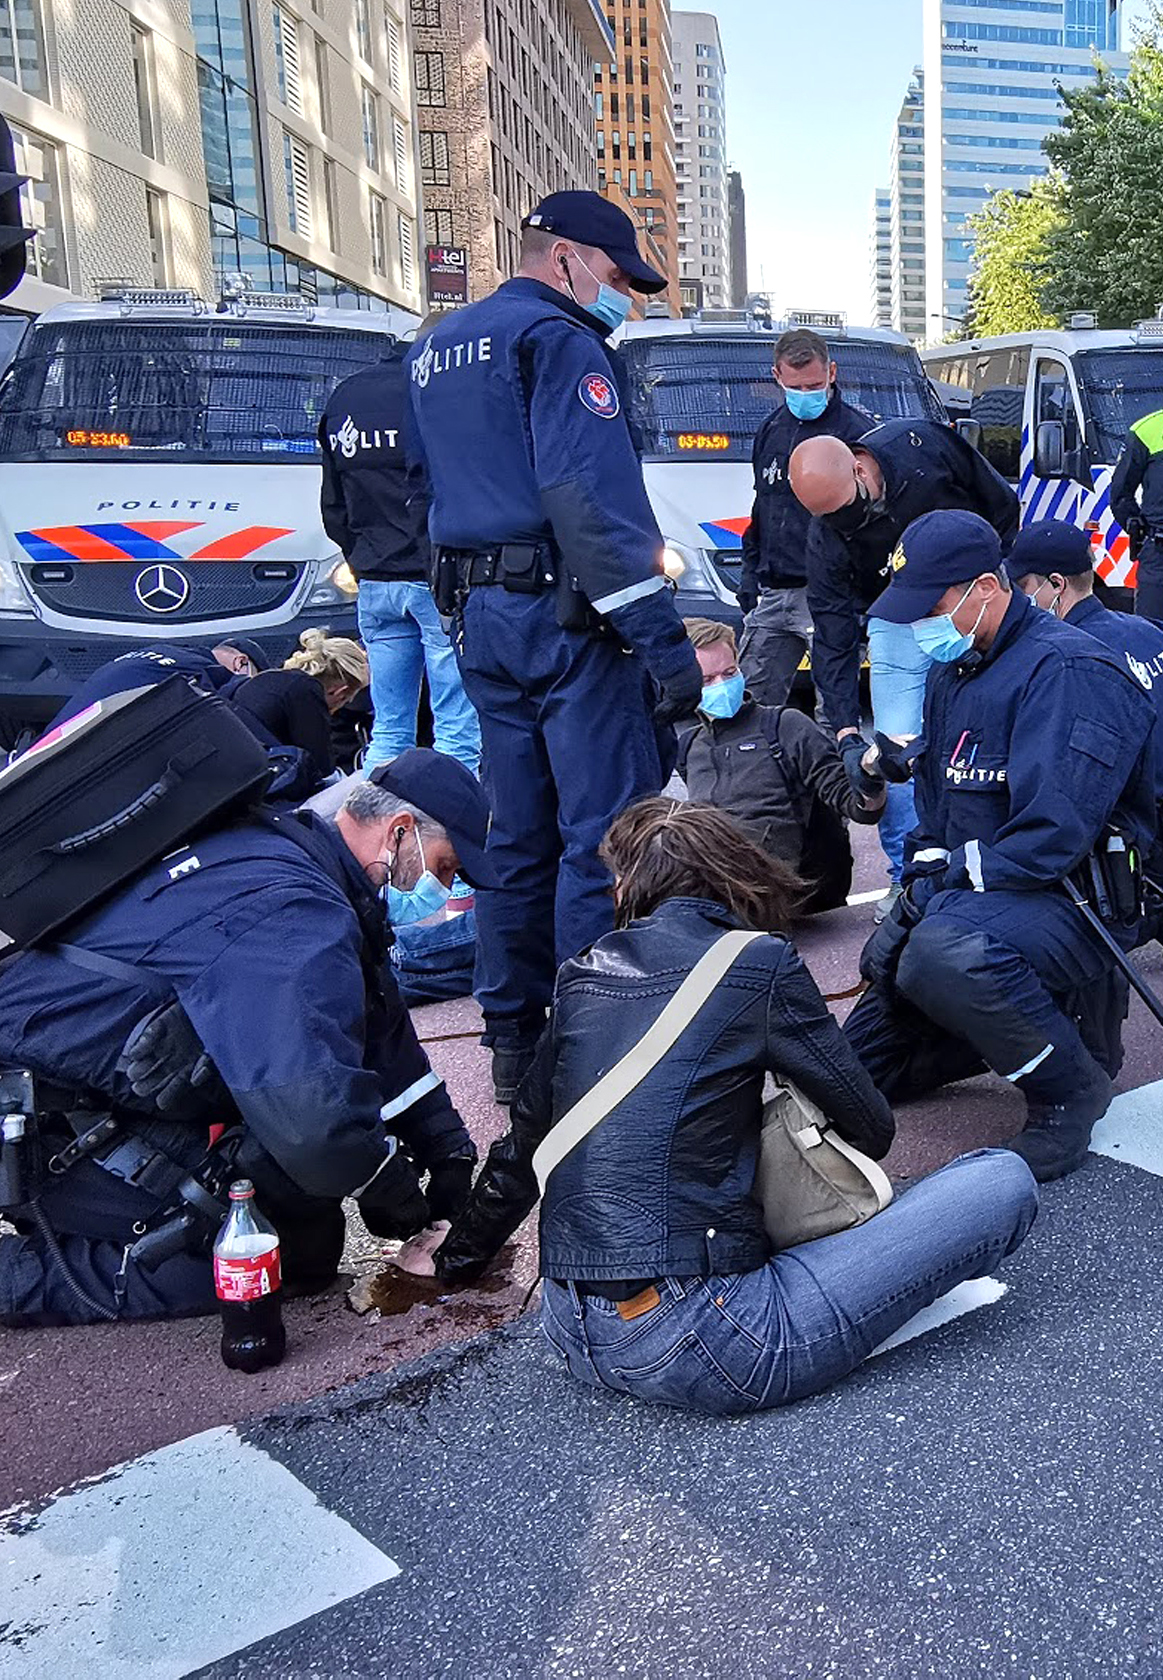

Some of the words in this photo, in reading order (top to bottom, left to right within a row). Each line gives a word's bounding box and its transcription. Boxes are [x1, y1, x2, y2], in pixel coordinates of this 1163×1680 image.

[411, 334, 492, 388] POLITIE
[329, 415, 398, 458] POLIT
[97, 499, 240, 512] POLITIE
[946, 758, 1006, 784] POLITIE
